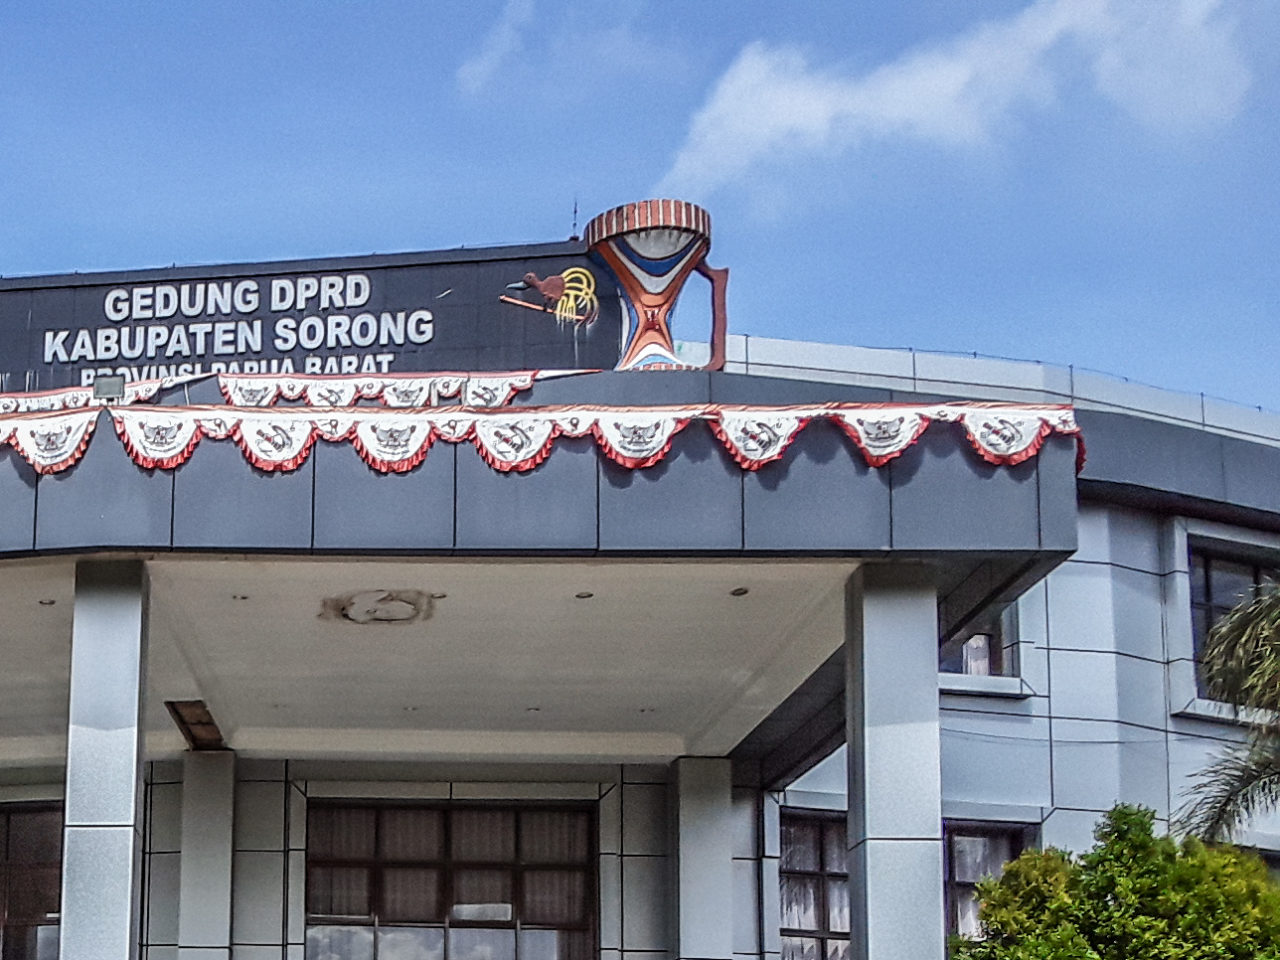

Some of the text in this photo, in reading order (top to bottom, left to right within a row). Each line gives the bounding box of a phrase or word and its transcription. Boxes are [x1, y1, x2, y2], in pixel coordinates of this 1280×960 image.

[104, 273, 371, 322] GEDUNG DPRD
[43, 310, 434, 364] KABUPATEN SORONG
[304, 353, 395, 375] BARAT
